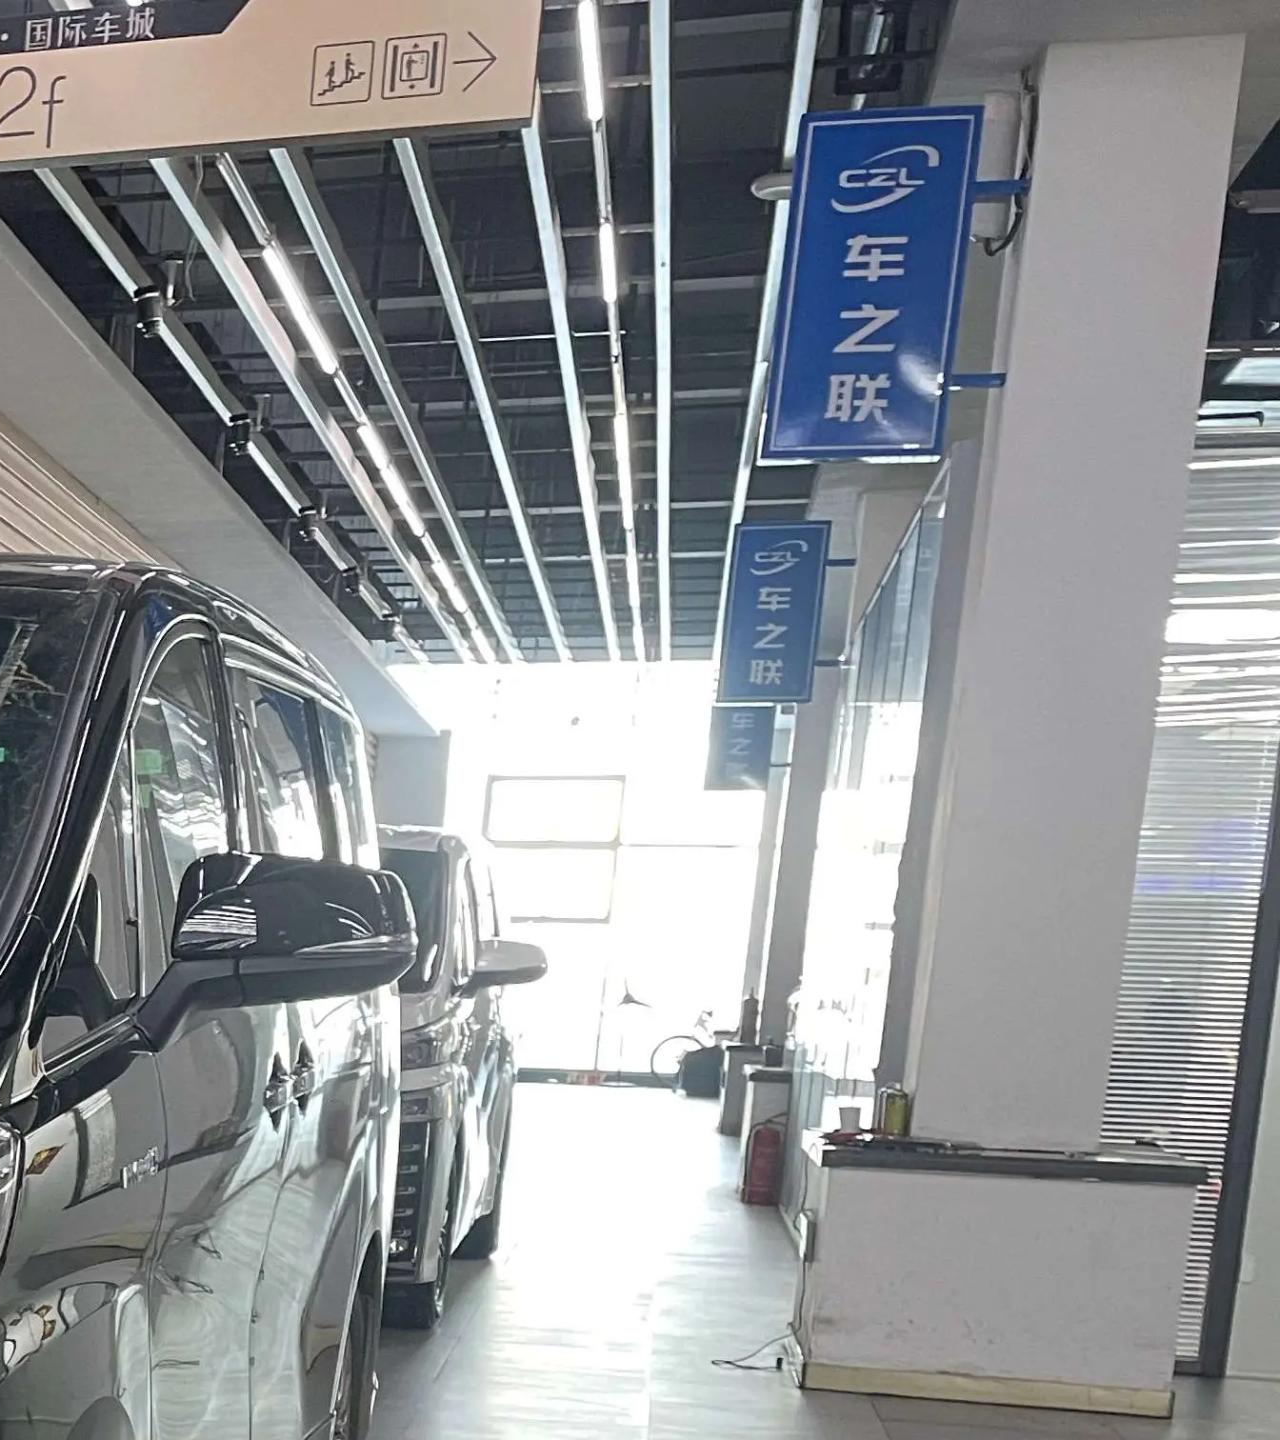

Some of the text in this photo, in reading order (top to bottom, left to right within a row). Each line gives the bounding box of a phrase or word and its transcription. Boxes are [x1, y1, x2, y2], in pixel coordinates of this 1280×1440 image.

[824, 233, 909, 424] 车之联
[749, 585, 792, 687] 车之联
